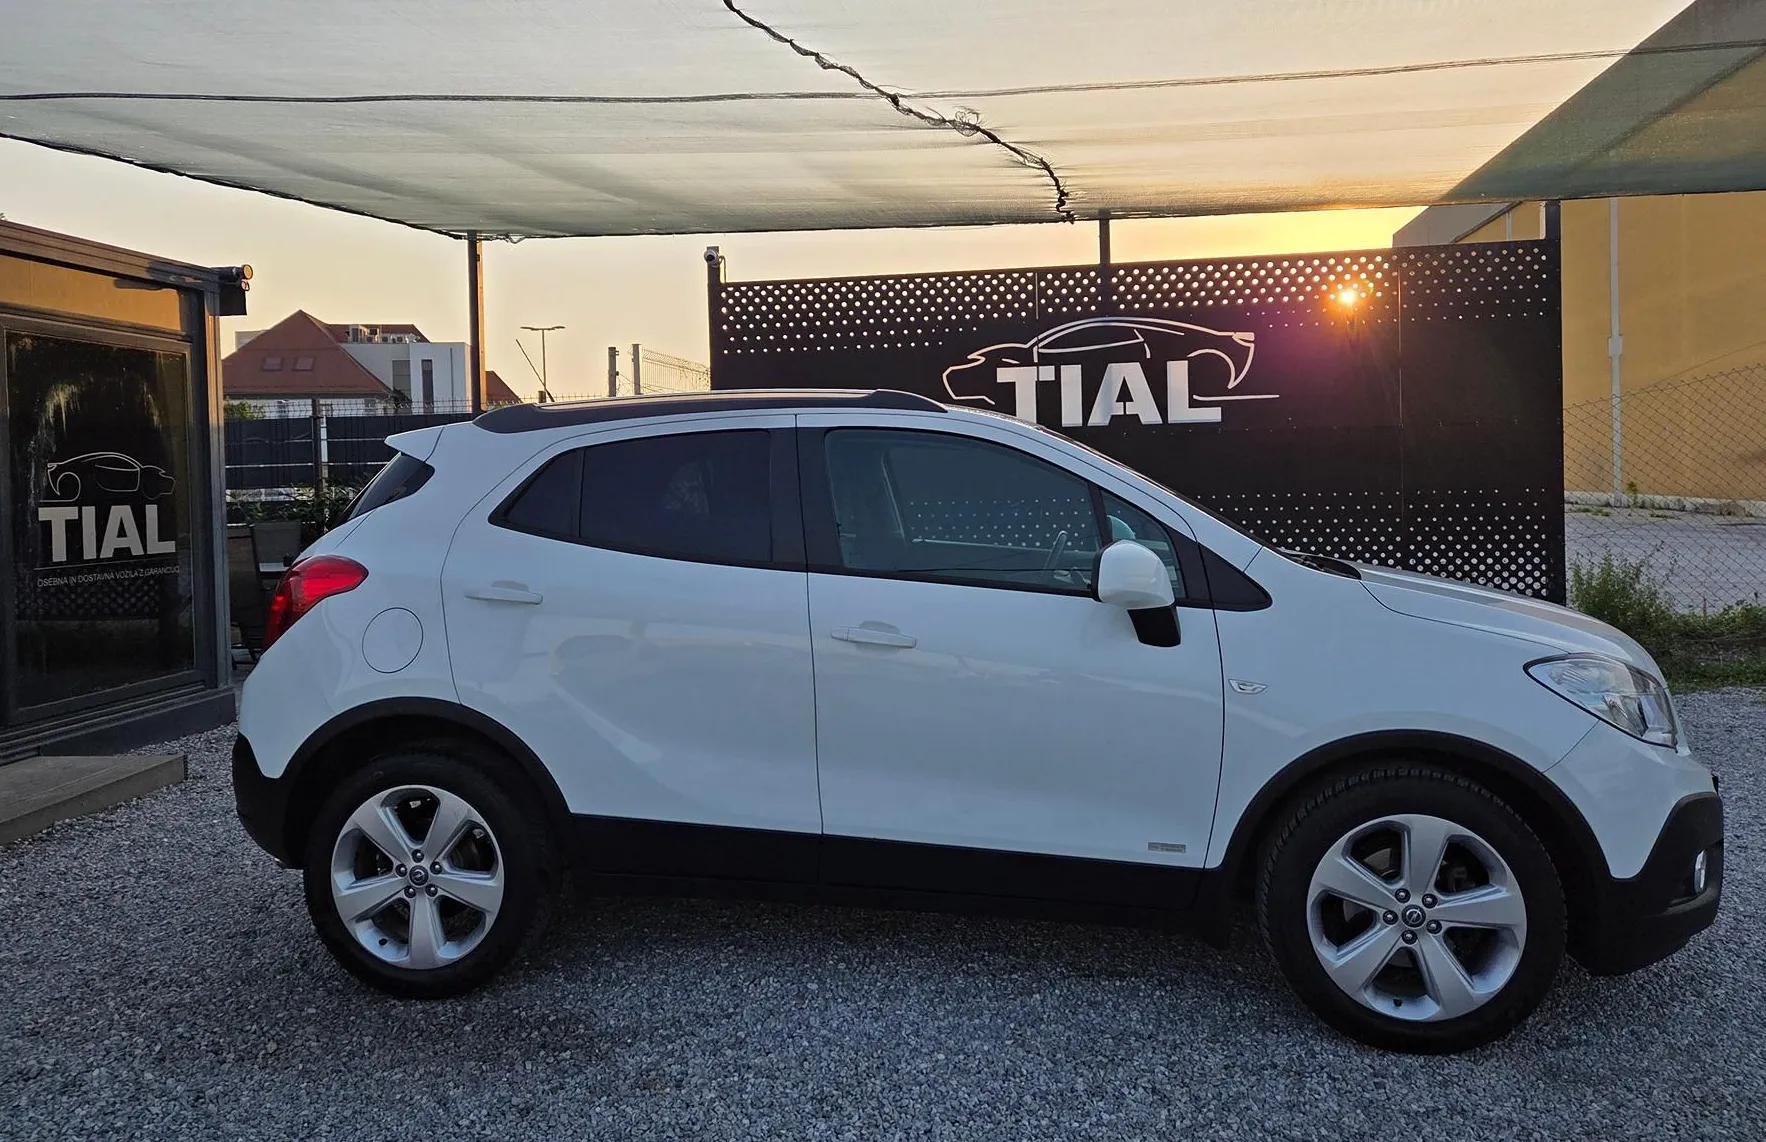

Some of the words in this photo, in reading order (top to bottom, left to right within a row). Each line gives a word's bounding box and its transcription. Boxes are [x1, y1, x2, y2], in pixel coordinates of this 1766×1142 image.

[996, 360, 1223, 428] TIAL
[37, 504, 176, 562] TIAL
[37, 576, 69, 587] OSEBNA
[69, 575, 77, 585] IN
[78, 571, 115, 583] DOSTAVNA
[116, 569, 139, 580] VOZILA
